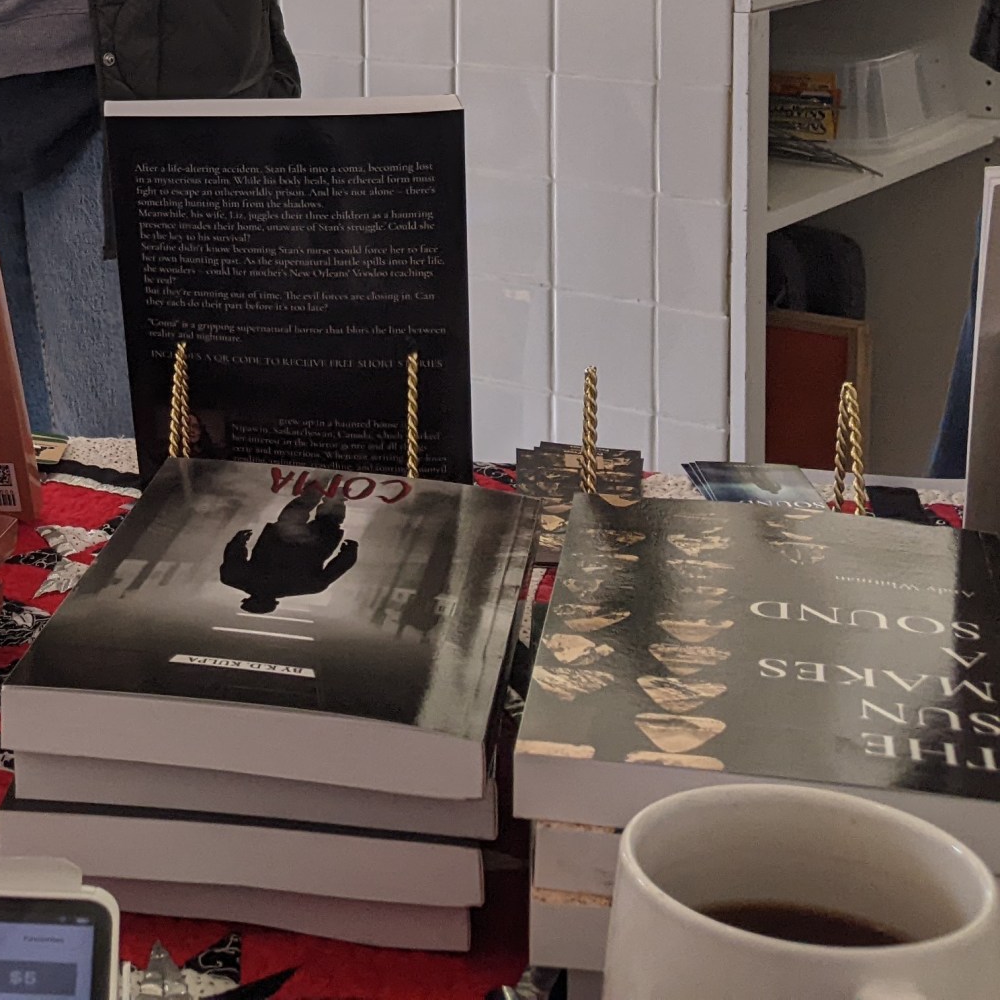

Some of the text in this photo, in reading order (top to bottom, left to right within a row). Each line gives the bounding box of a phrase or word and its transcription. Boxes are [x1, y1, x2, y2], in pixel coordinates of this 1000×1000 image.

[310, 164, 328, 173] into
[369, 162, 414, 175] becoming
[416, 161, 432, 172] lost
[242, 198, 264, 208] from
[267, 198, 280, 208] the
[332, 210, 369, 220] children
[270, 466, 413, 505] COMA
[835, 575, 975, 599] Andy Whitman
[750, 600, 981, 641] SOUND
[187, 657, 241, 667] KULPA
[940, 646, 987, 669] A
[281, 666, 303, 674] BY
[758, 658, 994, 703] MAKES
[861, 699, 1000, 735] SUN
[861, 731, 1000, 772] THE
[9, 969, 37, 986] $5
